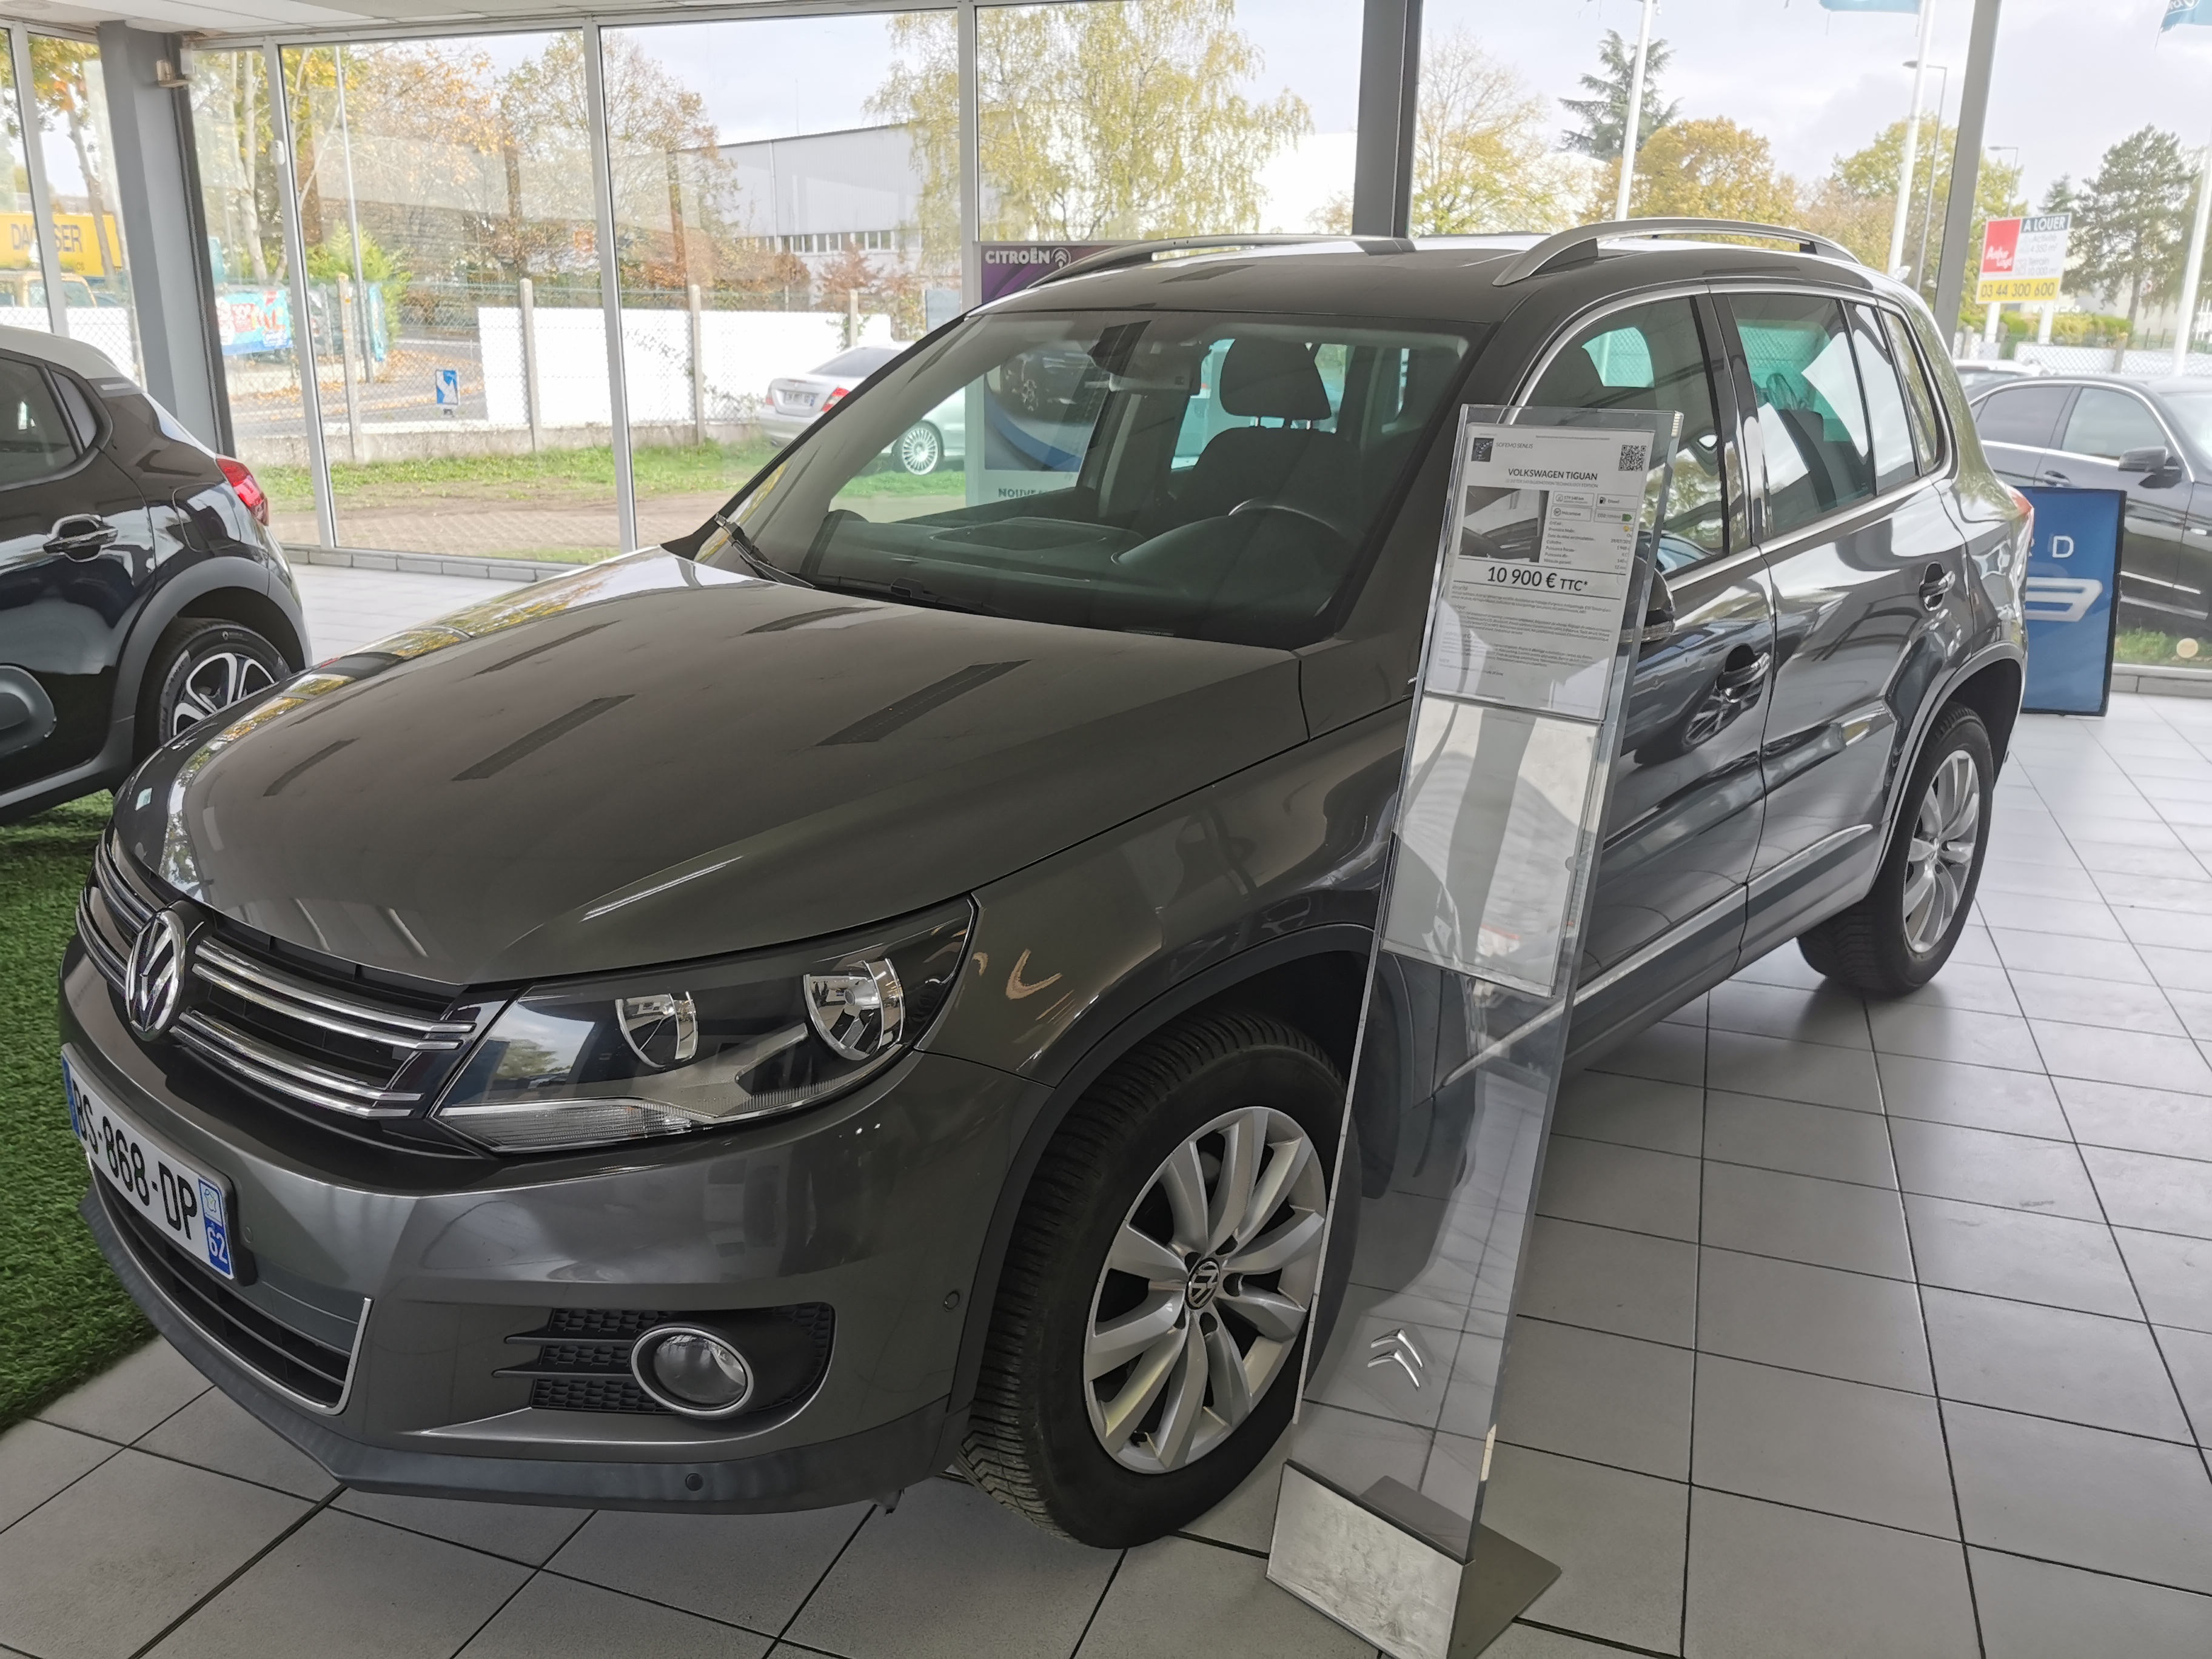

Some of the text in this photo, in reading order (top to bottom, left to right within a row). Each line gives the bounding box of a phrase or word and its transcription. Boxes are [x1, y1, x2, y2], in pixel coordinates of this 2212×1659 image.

[2023, 216, 2066, 232] A LOUER
[10, 223, 84, 253] DASER
[985, 247, 1051, 264] CITROËN
[1980, 282, 2055, 298] 03 44 300 600
[1508, 468, 1598, 481] VOLKSWAGEN TIGUAN
[1487, 566, 1507, 583] 10
[1512, 569, 1543, 587] 900
[1546, 572, 1558, 589] €
[72, 1077, 198, 1241] BS-868-DP
[207, 1226, 229, 1264] 62
